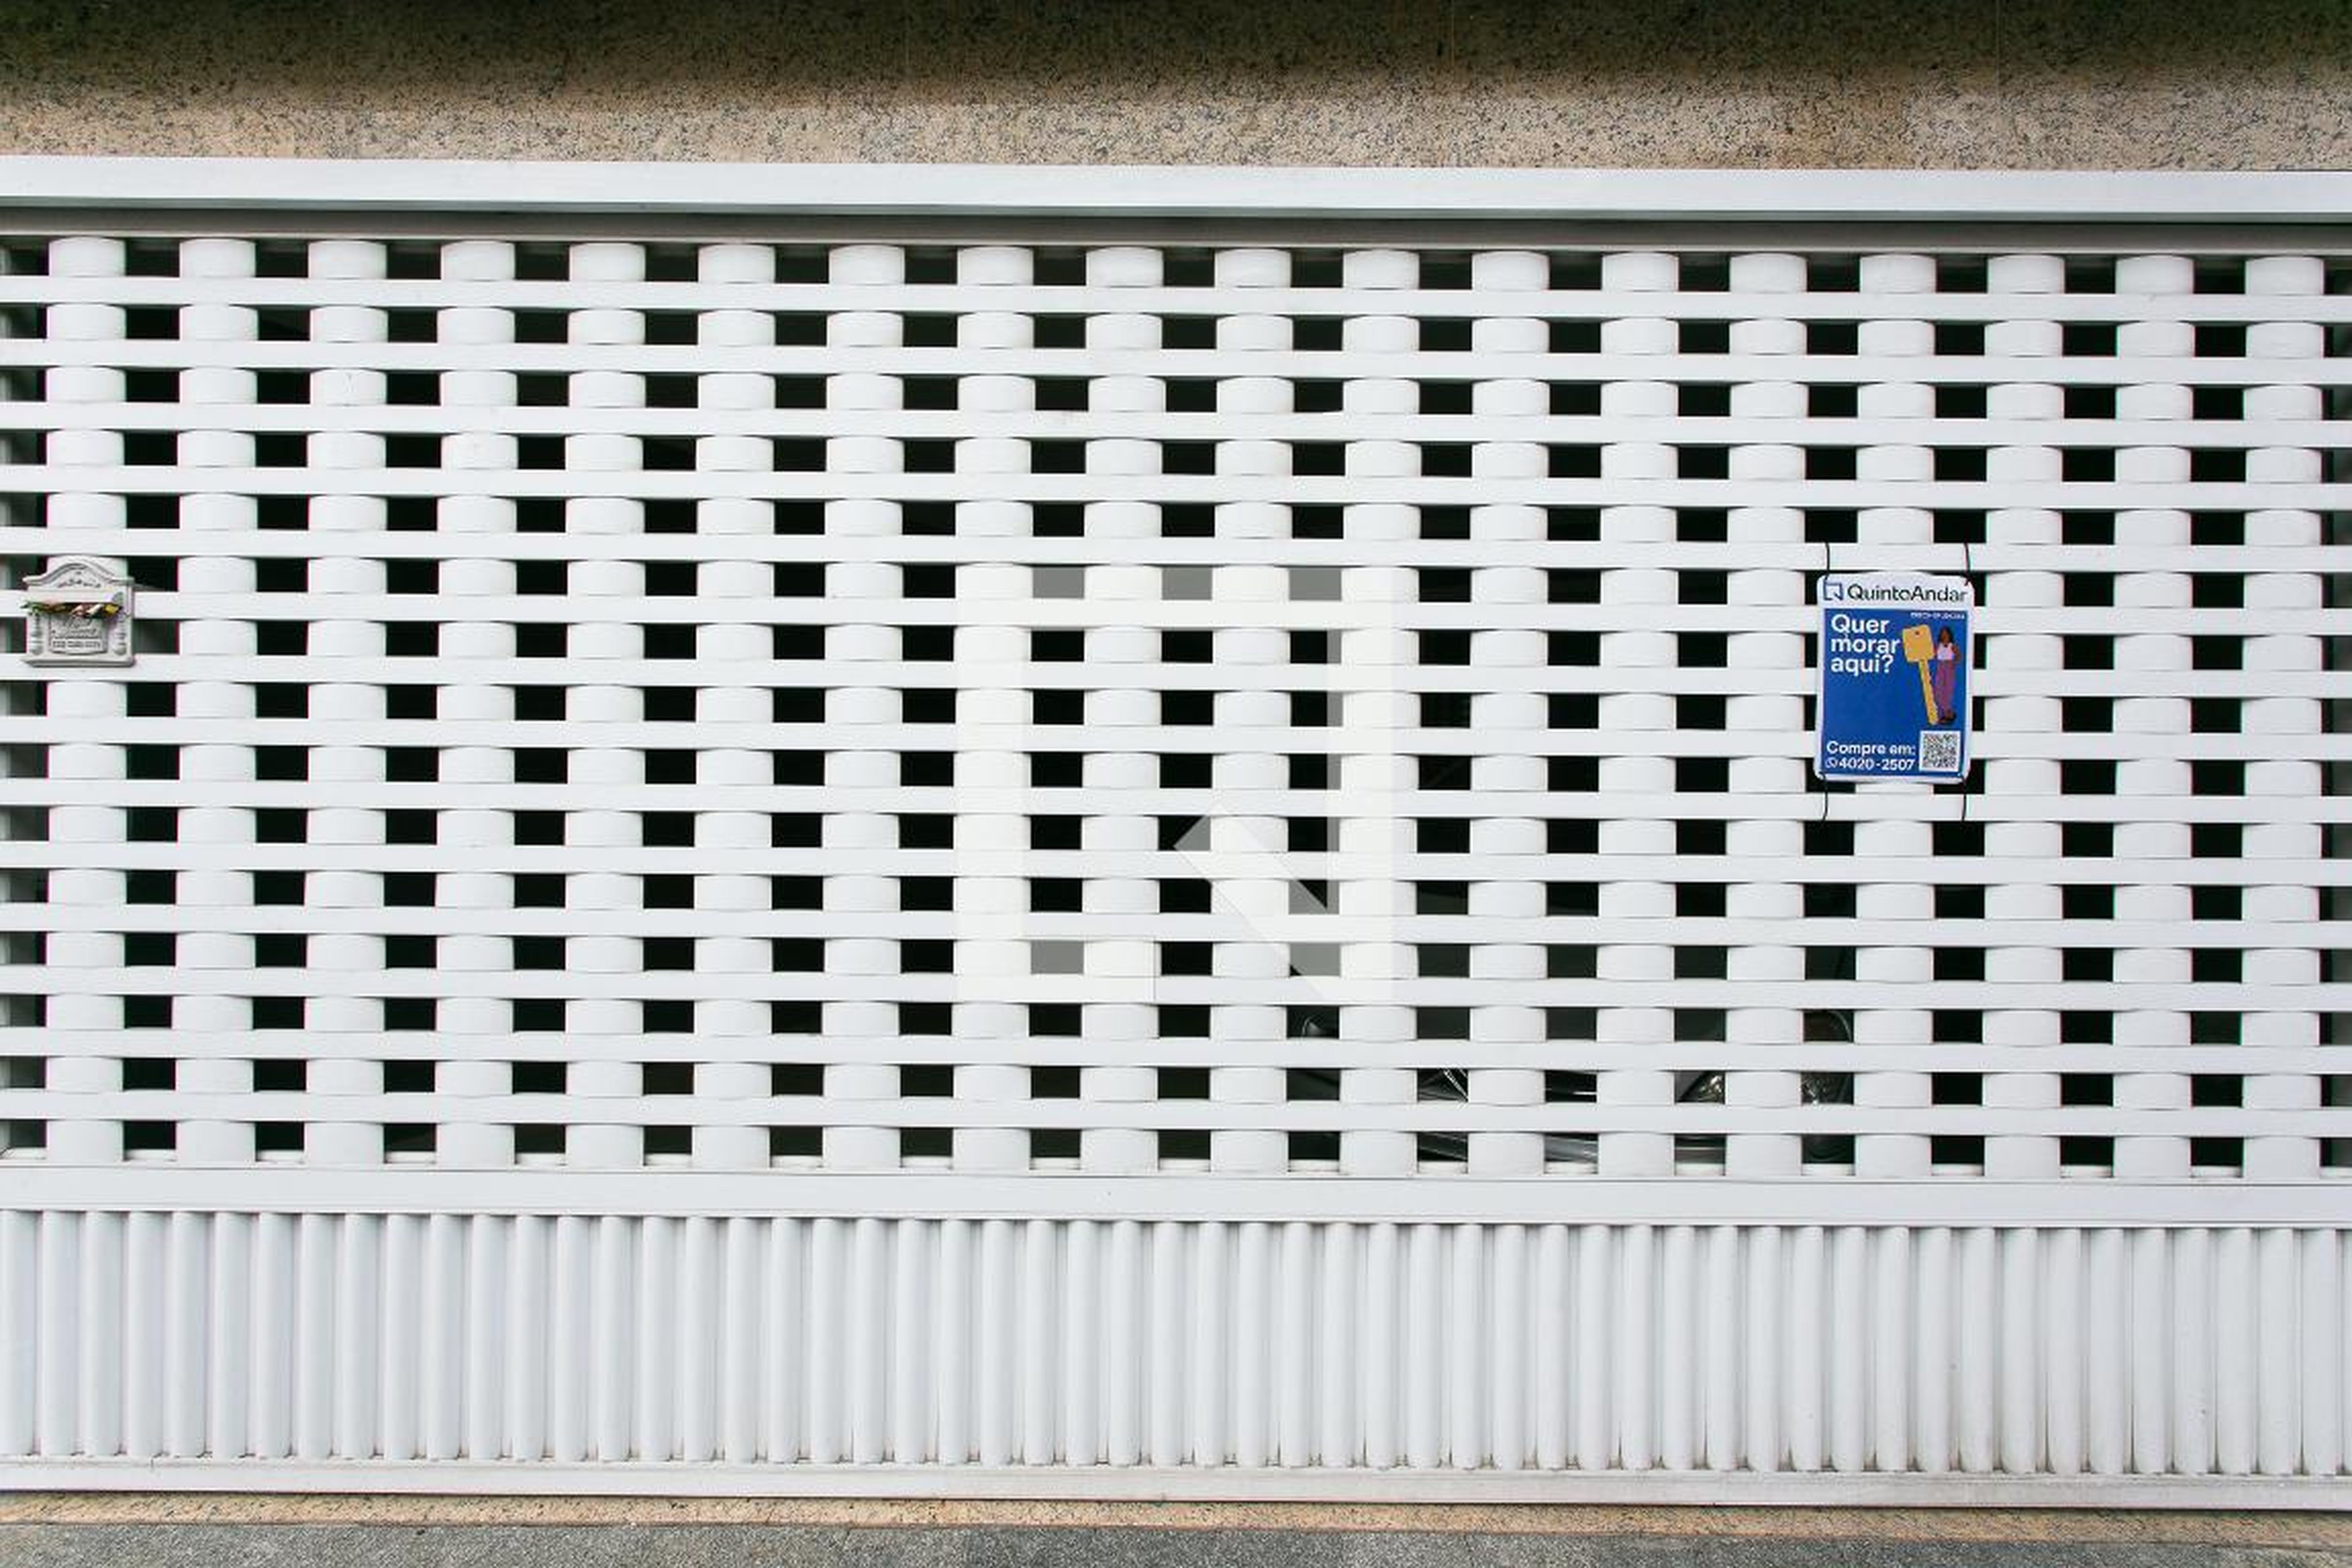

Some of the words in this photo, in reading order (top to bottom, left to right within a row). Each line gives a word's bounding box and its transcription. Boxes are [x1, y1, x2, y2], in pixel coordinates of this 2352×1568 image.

[1847, 583, 1967, 602] QuintoAndar
[1831, 614, 1890, 634] Quer
[1830, 638, 1900, 654] morar
[1830, 655, 1894, 676] aqui?
[1826, 740, 1886, 759] Compre
[1889, 745, 1916, 756] em:
[1839, 757, 1915, 771] 4020-2507
